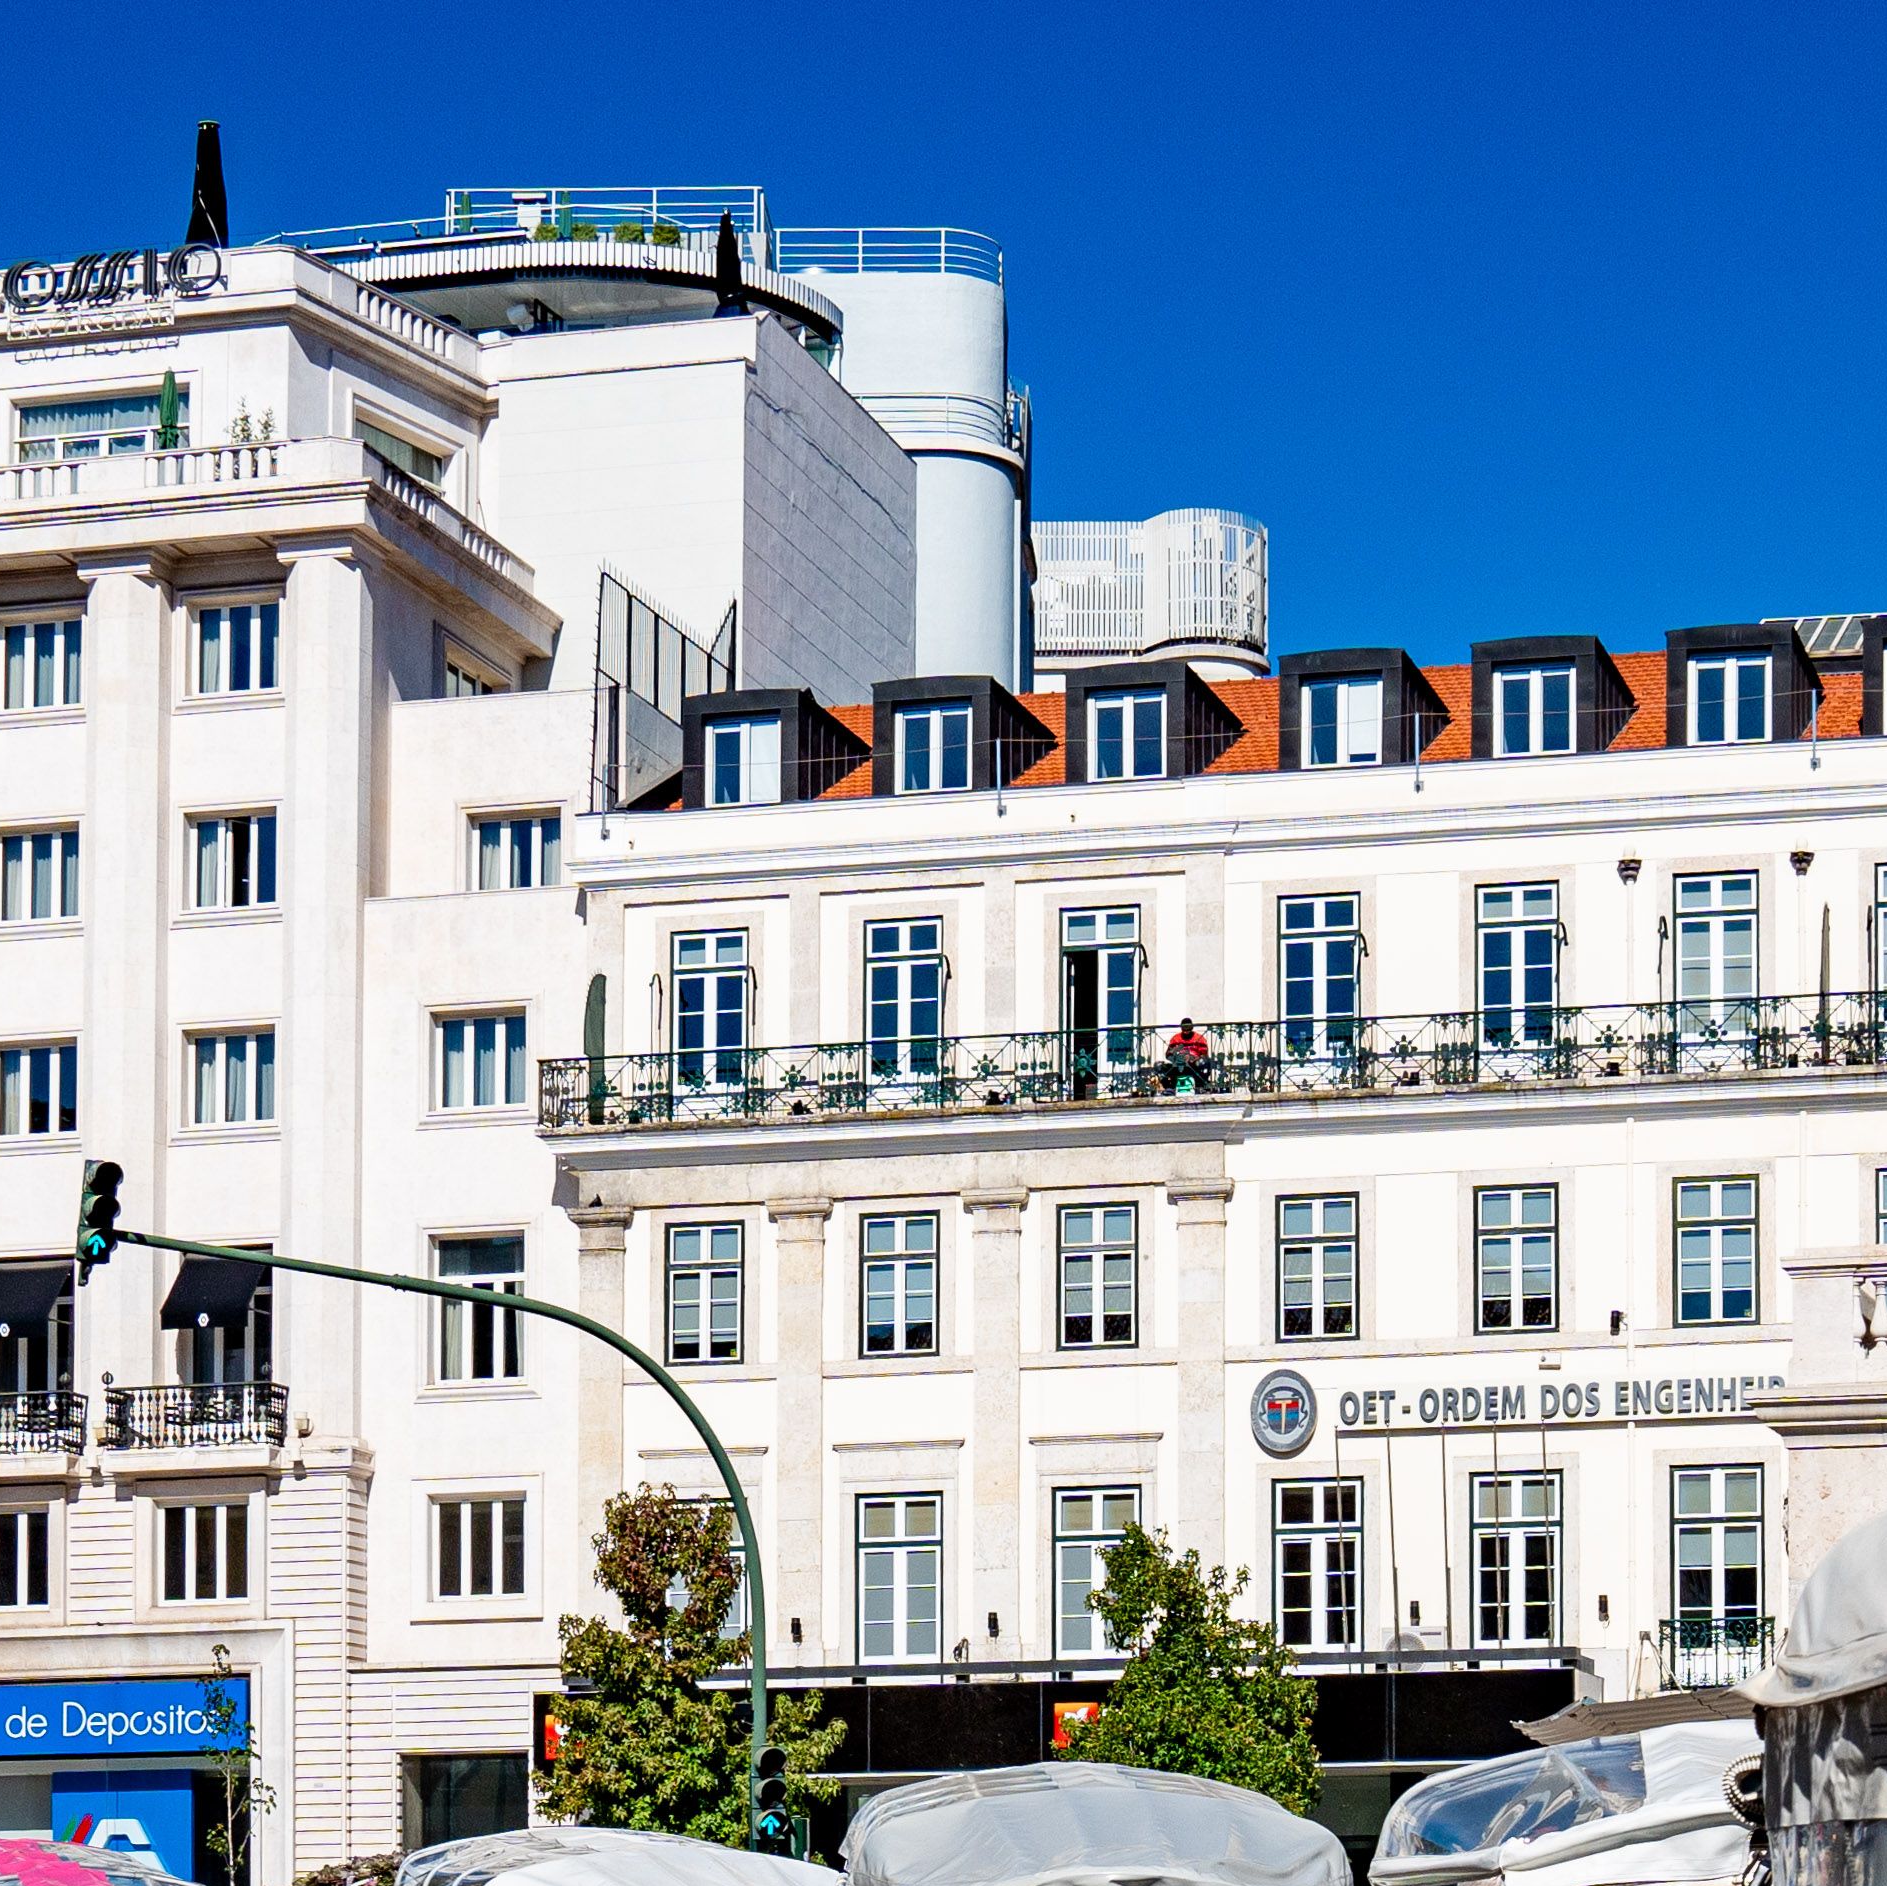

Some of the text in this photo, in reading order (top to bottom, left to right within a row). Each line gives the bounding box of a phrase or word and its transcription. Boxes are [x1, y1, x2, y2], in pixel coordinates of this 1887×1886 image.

[1340, 1389, 1396, 1426] OET
[1418, 1384, 1526, 1424] ORDEM
[1541, 1381, 1601, 1419] DOS
[5, 1705, 47, 1739] de
